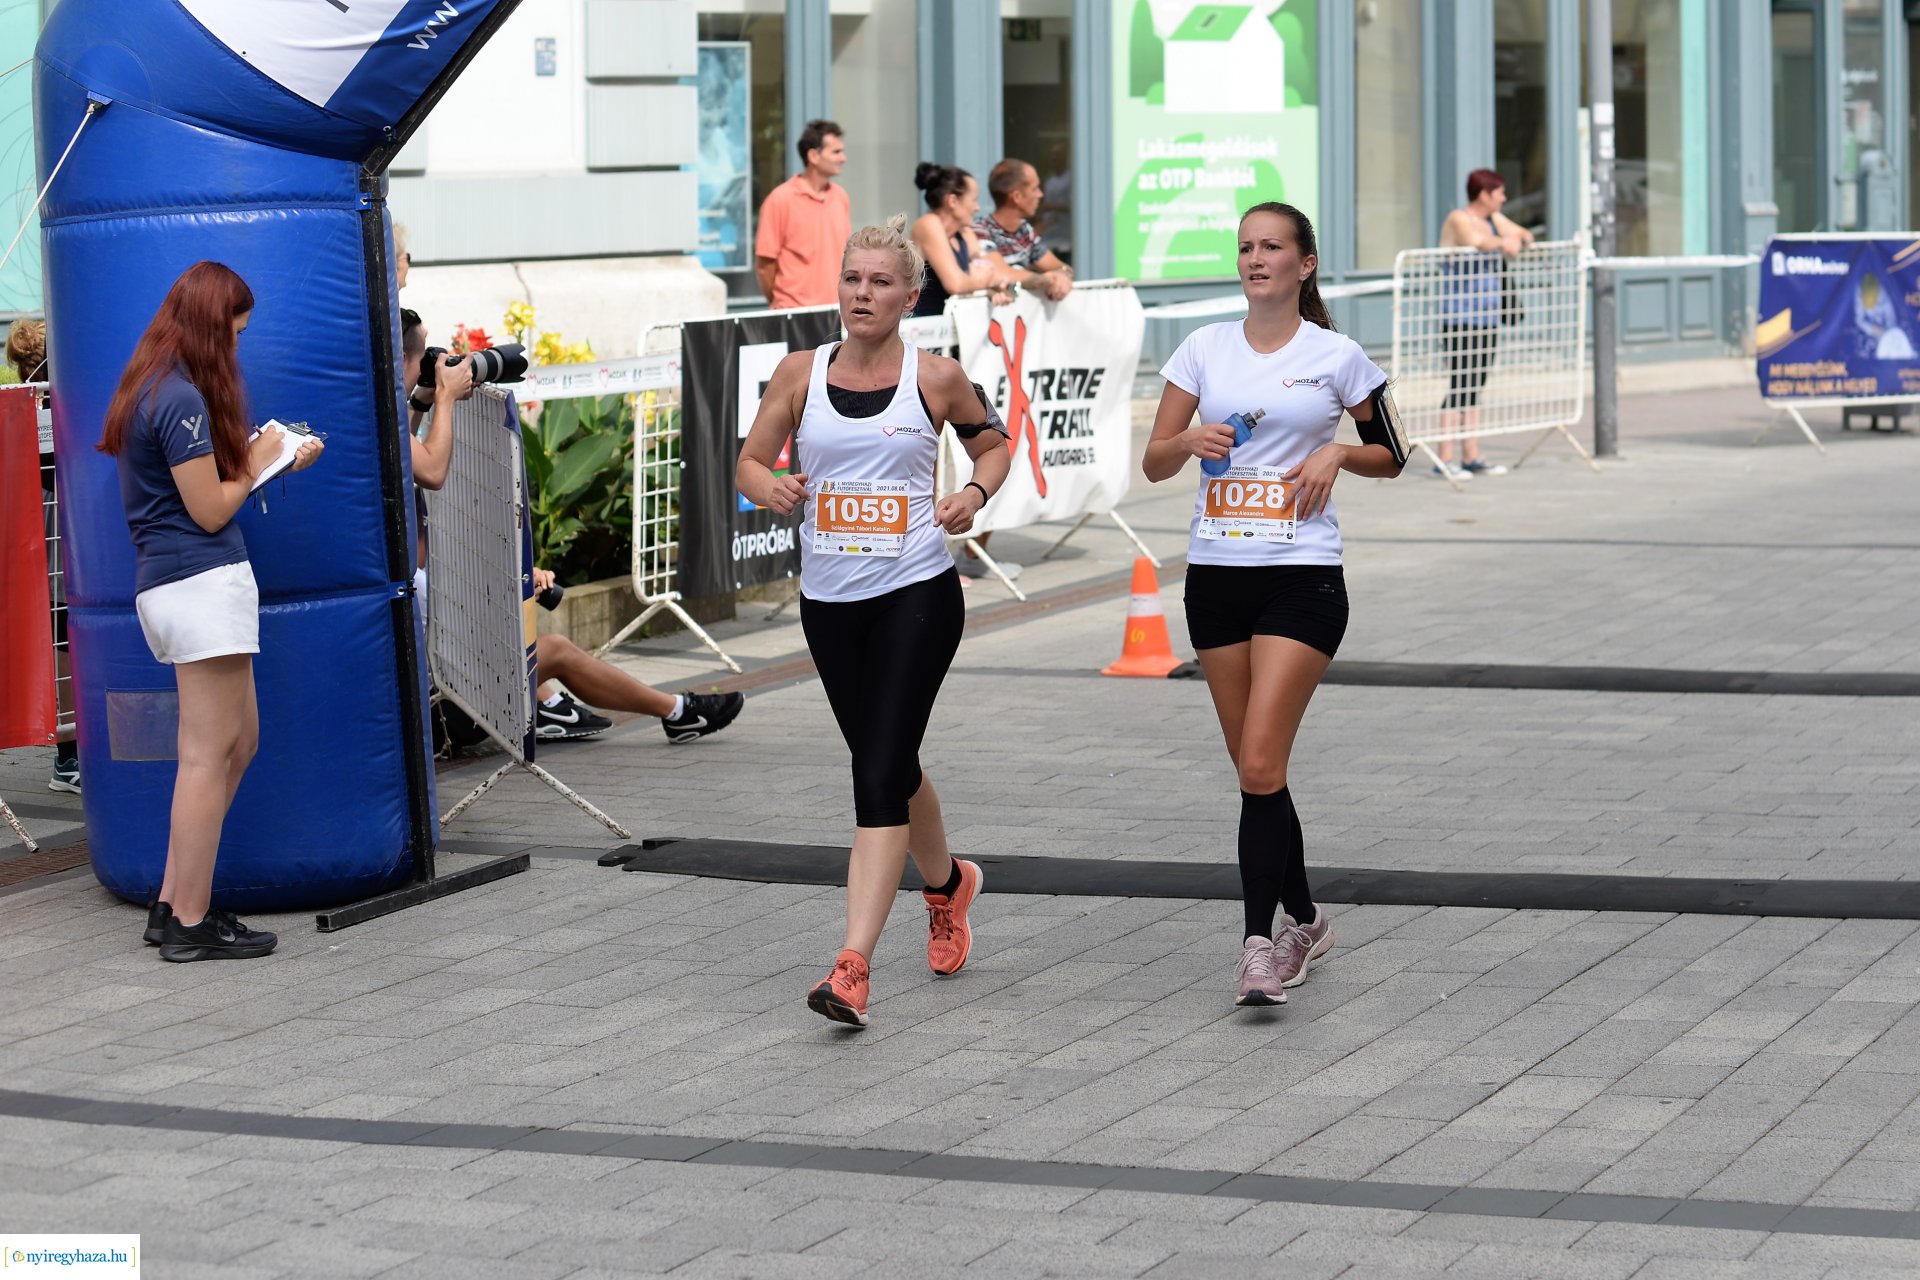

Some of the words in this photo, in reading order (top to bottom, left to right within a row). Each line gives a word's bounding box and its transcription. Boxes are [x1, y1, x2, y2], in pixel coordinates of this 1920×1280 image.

[1138, 173, 1157, 190] az
[1159, 168, 1193, 190] OTP
[1295, 377, 1321, 386] MOZAIK
[896, 426, 922, 434] MOZAIK
[1039, 407, 1094, 440] TRAIL
[1211, 482, 1285, 509] 1028
[825, 496, 900, 523] 1059
